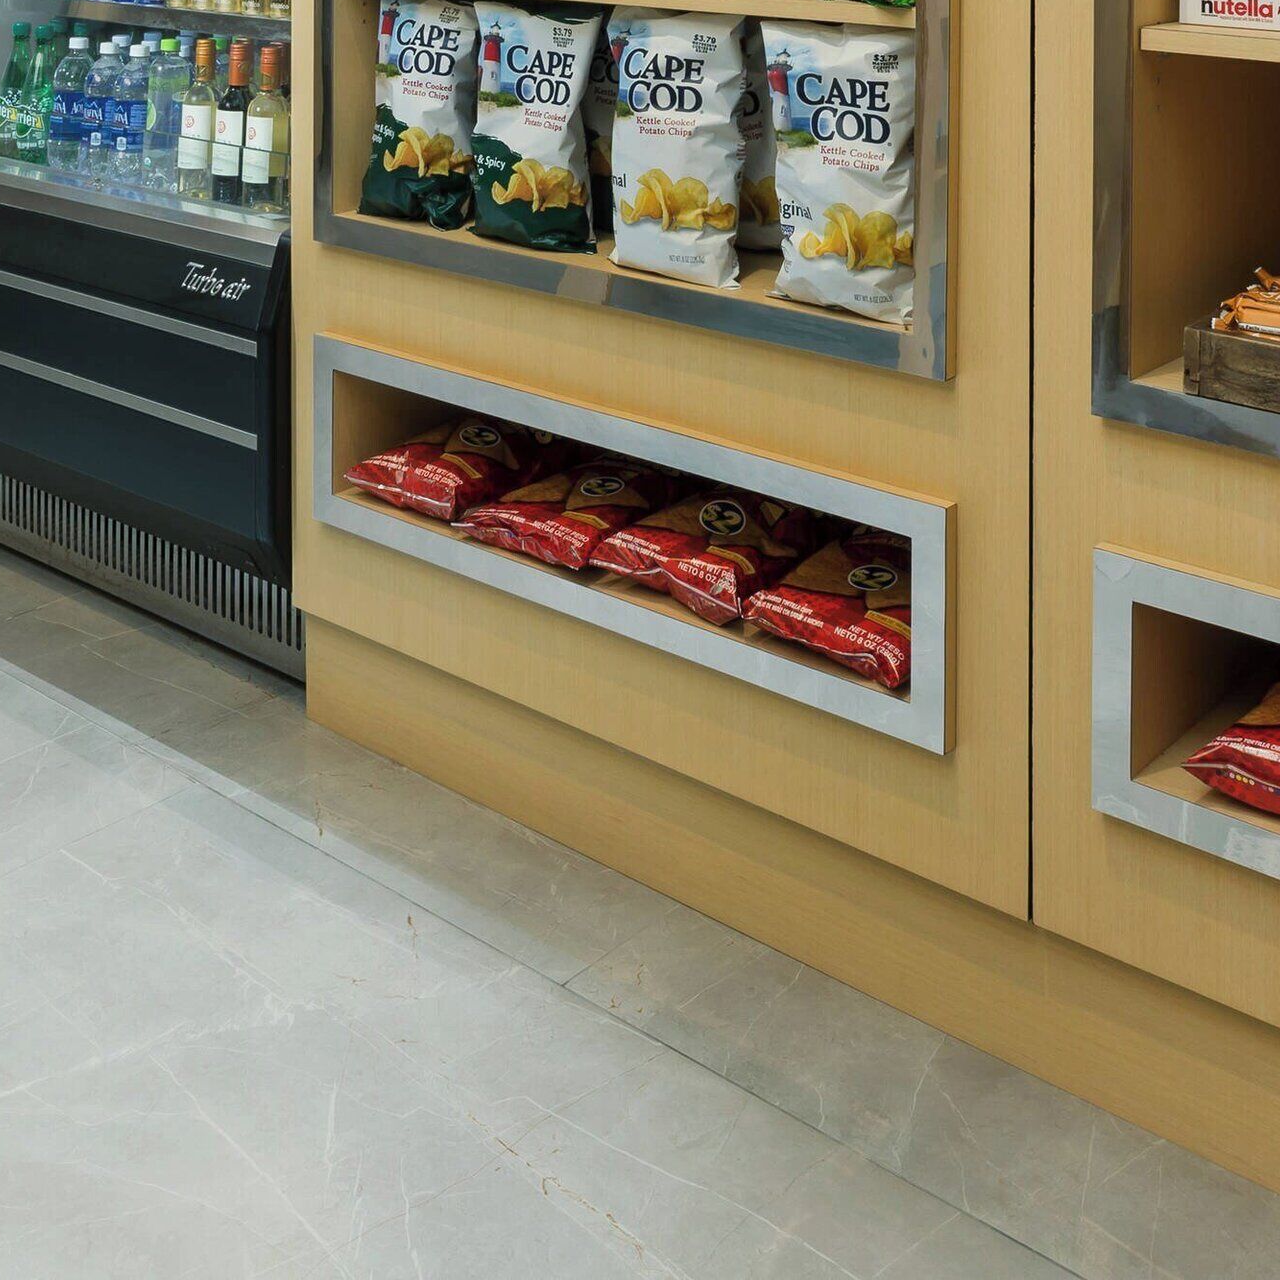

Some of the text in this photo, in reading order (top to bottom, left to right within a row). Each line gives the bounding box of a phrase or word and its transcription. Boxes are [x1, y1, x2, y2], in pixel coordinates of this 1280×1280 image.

[396, 19, 461, 51] CAPE
[553, 27, 572, 37] $3.79
[398, 47, 455, 76] COD
[506, 45, 576, 79] CAPE
[623, 48, 705, 84] CAPE
[402, 78, 452, 92] Kettle Cooked
[515, 75, 571, 106] COD
[795, 72, 890, 112] CAPE
[403, 88, 449, 101] Potato Chips
[627, 83, 703, 114] COD
[525, 108, 566, 122] Kettle Cooked
[636, 116, 696, 128] Kettle Cooked
[544, 122, 562, 131] Chips
[639, 126, 692, 137] Potato Chips
[811, 107, 892, 145] COD
[820, 145, 885, 161] Kettle Cooked
[484, 156, 506, 170] Spicy
[822, 156, 880, 172] Potato Chips
[678, 562, 699, 578] NETO
[834, 627, 858, 642] NETO
